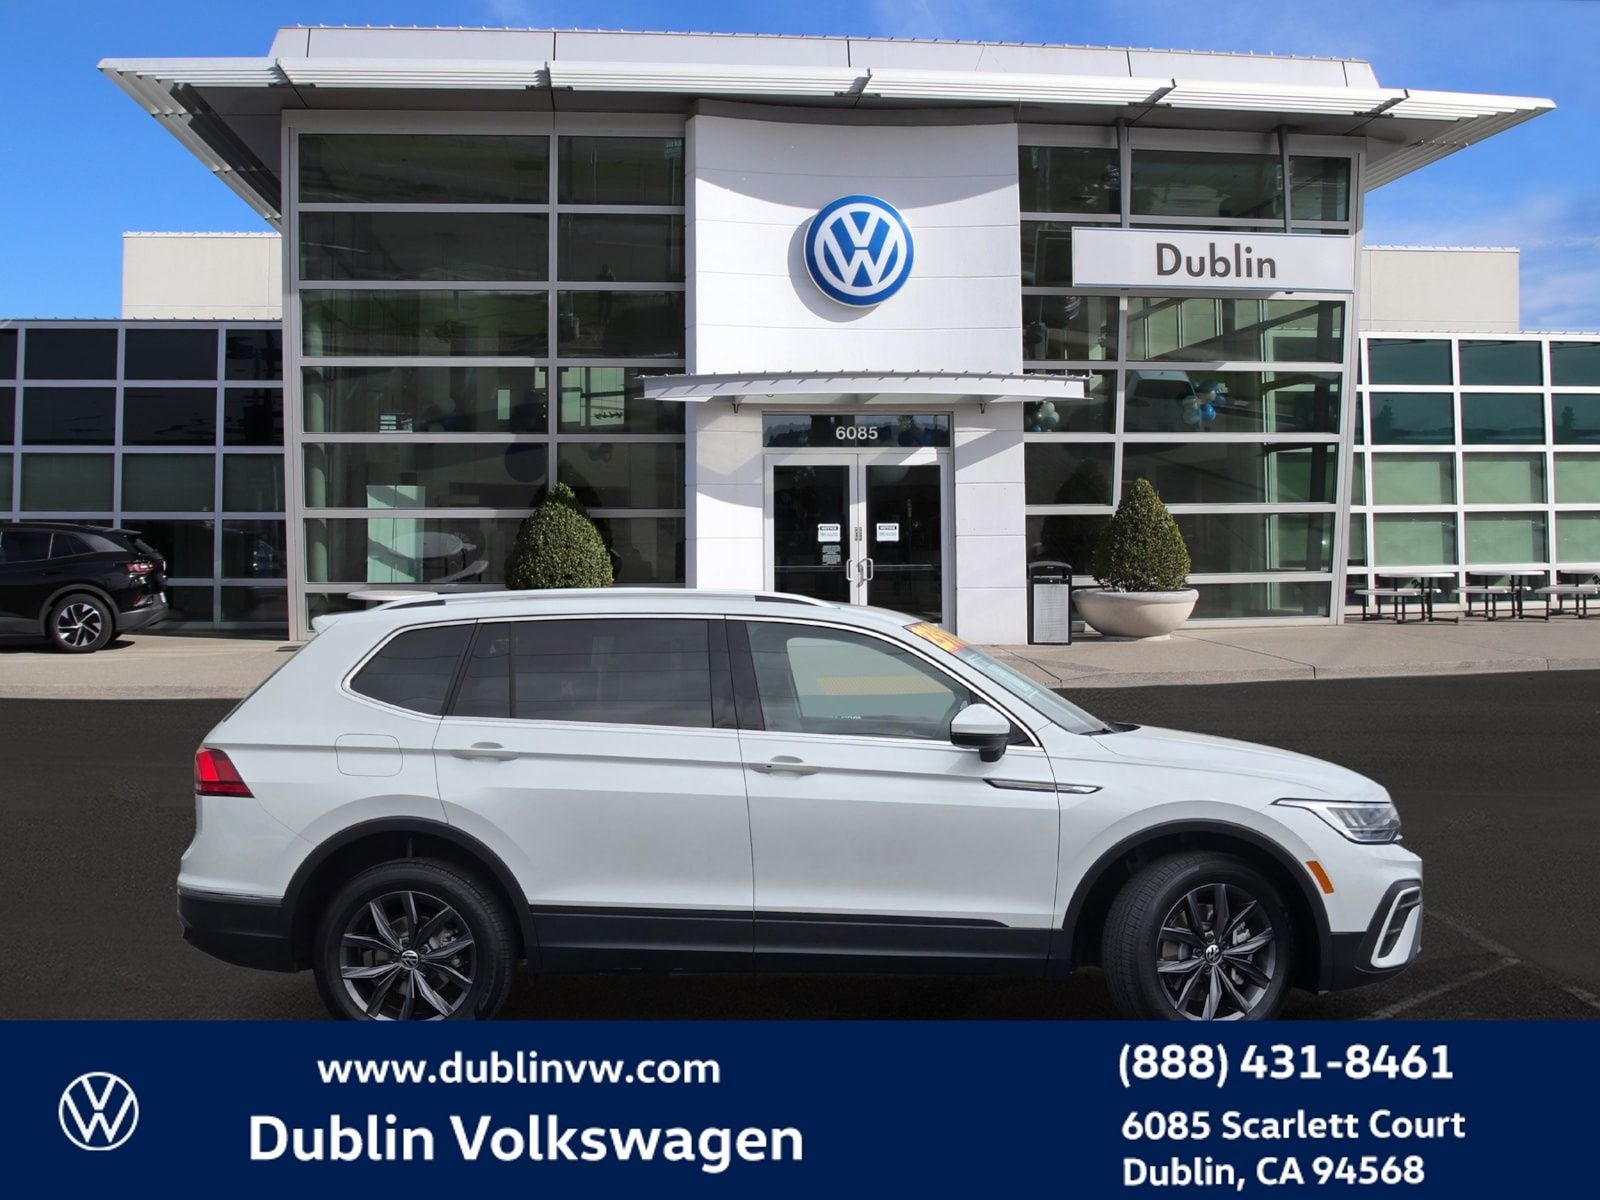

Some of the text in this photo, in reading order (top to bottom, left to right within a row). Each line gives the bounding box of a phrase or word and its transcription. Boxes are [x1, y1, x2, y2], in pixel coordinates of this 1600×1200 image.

[809, 199, 911, 301] VW
[1157, 243, 1277, 279] Dublin
[835, 426, 878, 440] 6085
